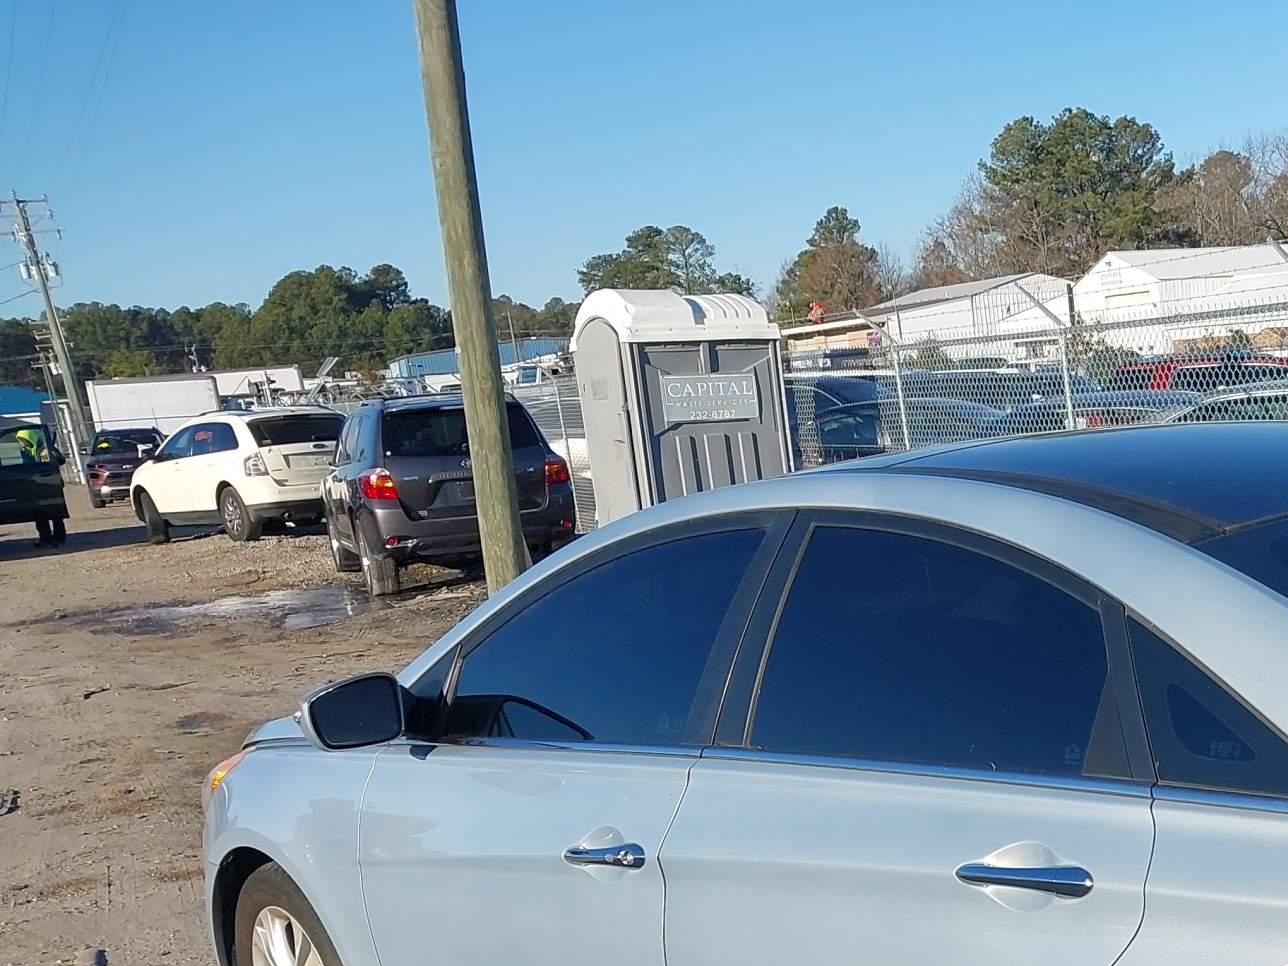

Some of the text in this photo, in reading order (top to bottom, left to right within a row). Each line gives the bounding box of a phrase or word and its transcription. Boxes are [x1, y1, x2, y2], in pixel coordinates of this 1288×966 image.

[667, 381, 753, 397] CAPITAL
[675, 399, 748, 408] WASTE SERVICES
[690, 409, 736, 419] 232-8787
